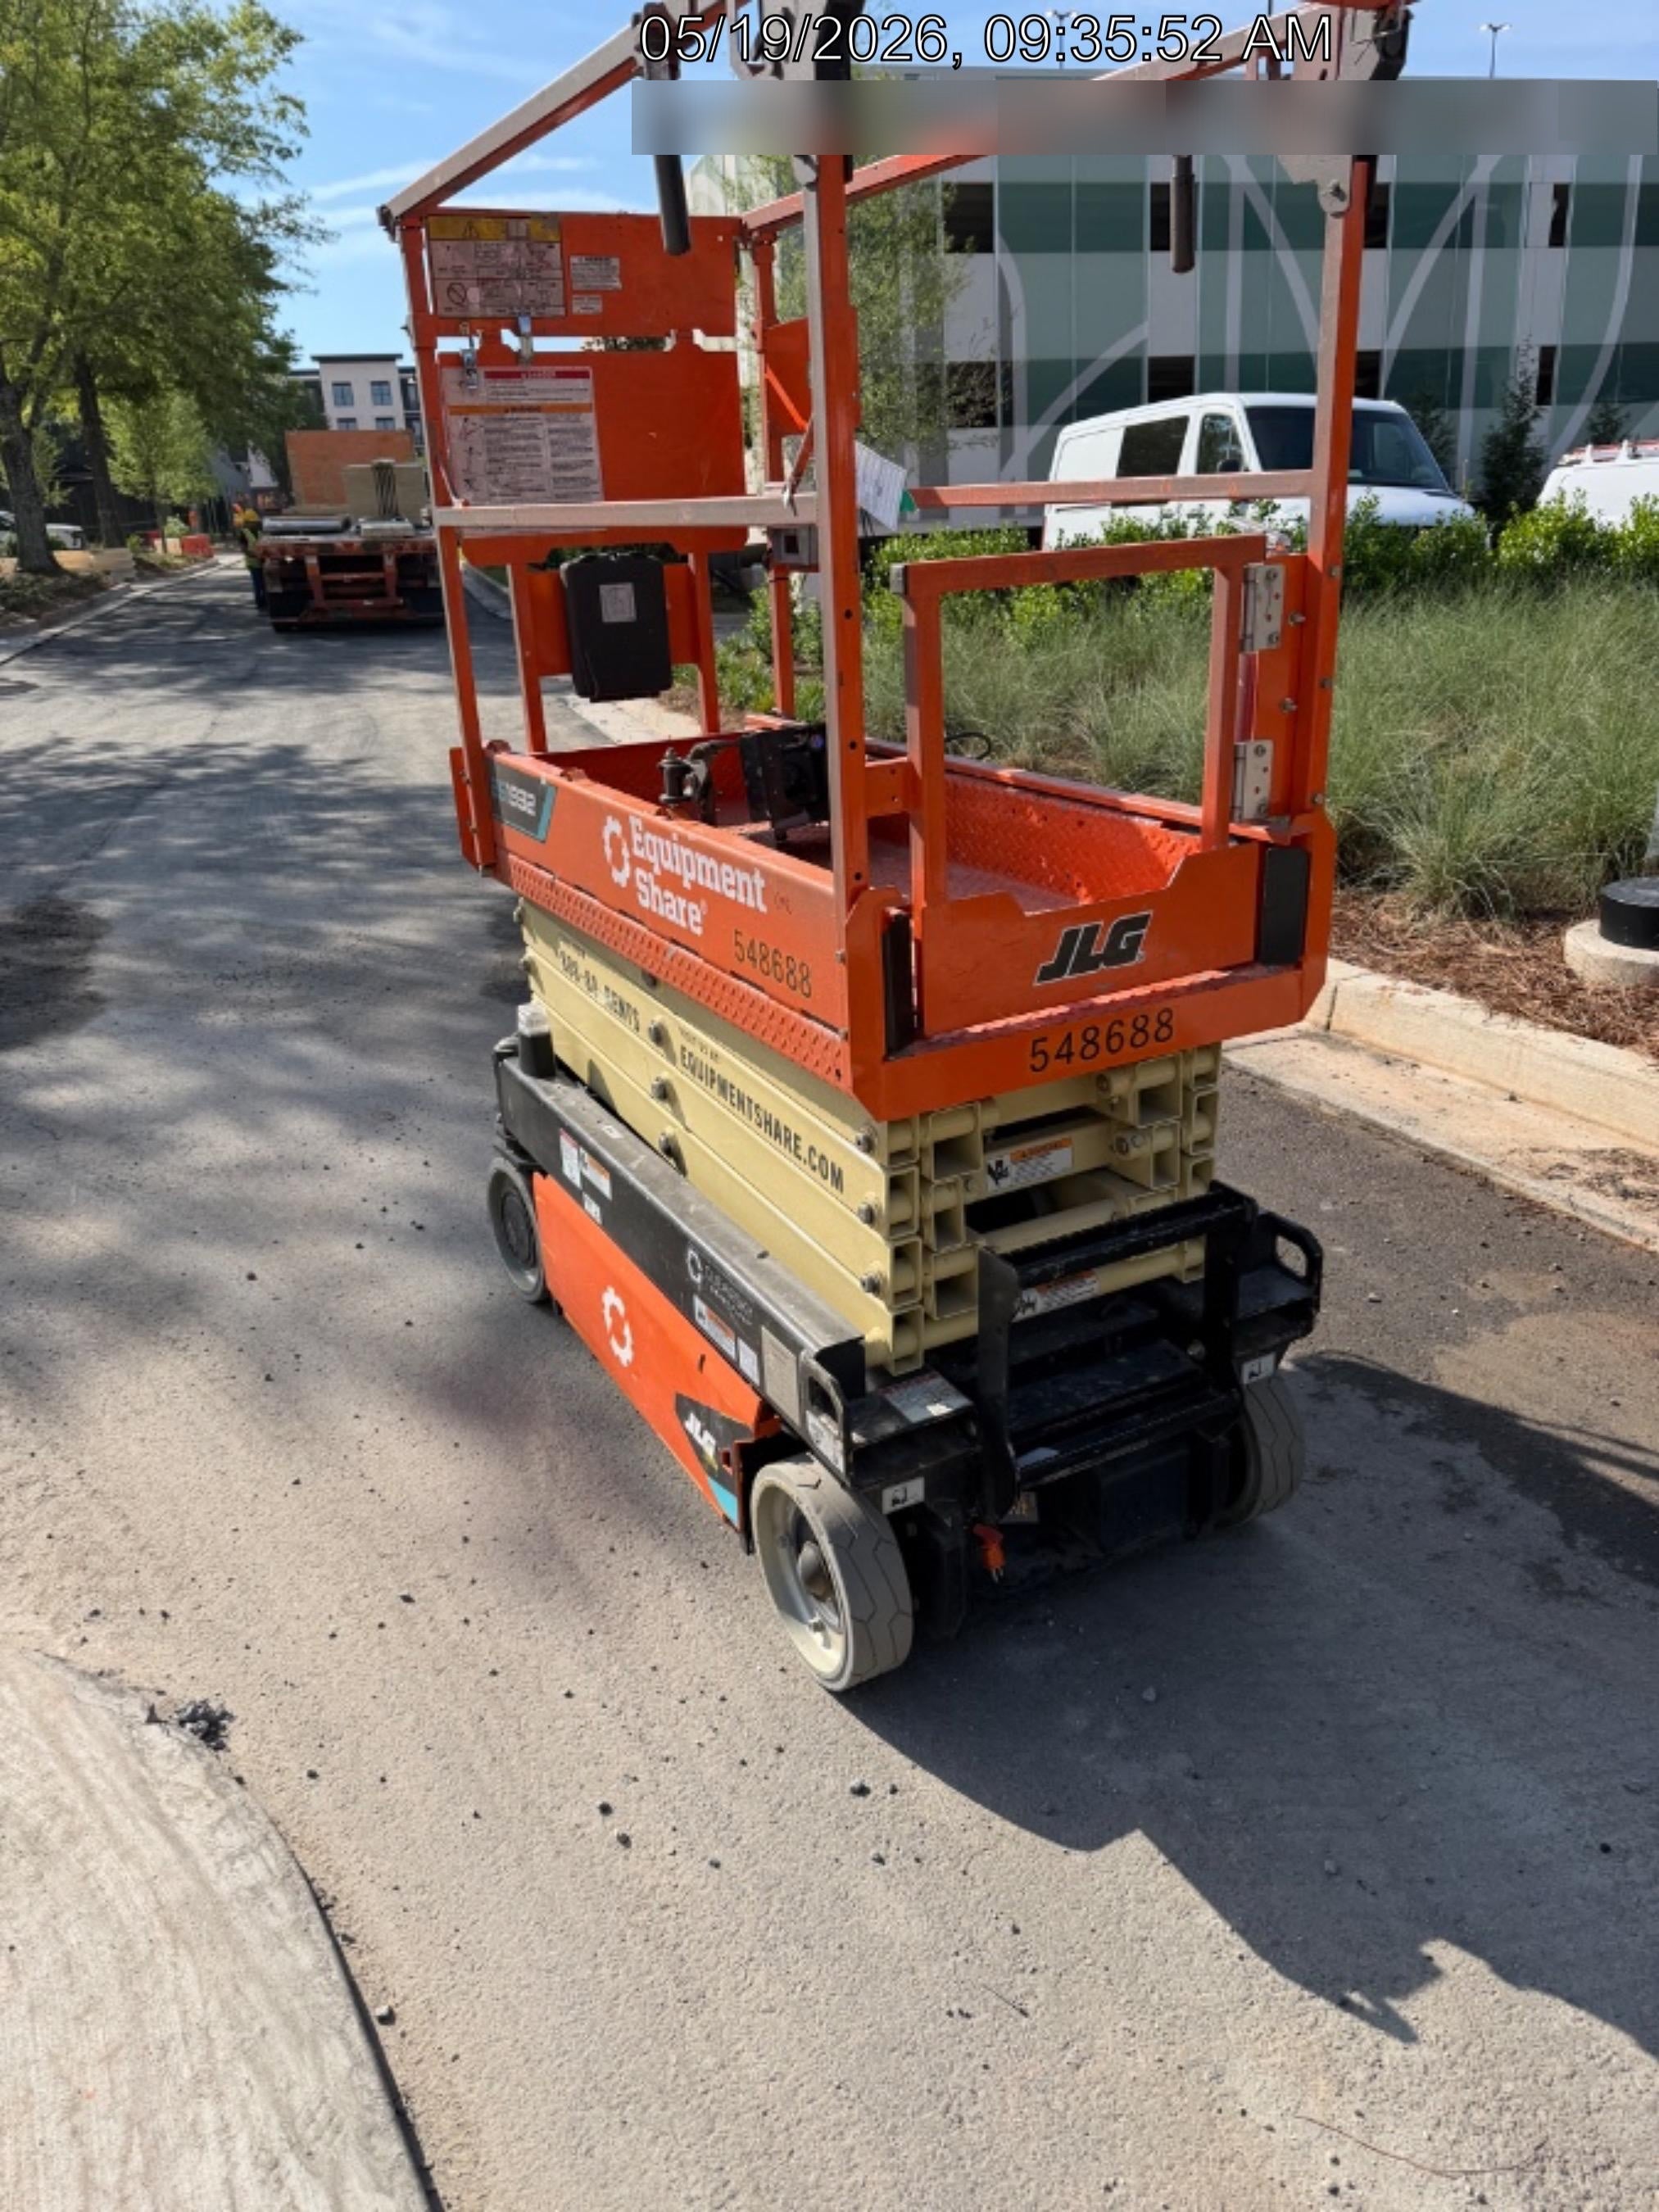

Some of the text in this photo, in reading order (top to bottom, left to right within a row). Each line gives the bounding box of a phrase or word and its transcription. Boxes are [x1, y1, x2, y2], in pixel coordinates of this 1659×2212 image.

[629, 815, 768, 913] Equipment
[636, 867, 705, 936] Share
[734, 927, 813, 999] 548688
[1033, 909, 1153, 986] JLG
[1030, 1007, 1173, 1072] 548688
[679, 1044, 845, 1194] EQUIPMENTSHARE.COM
